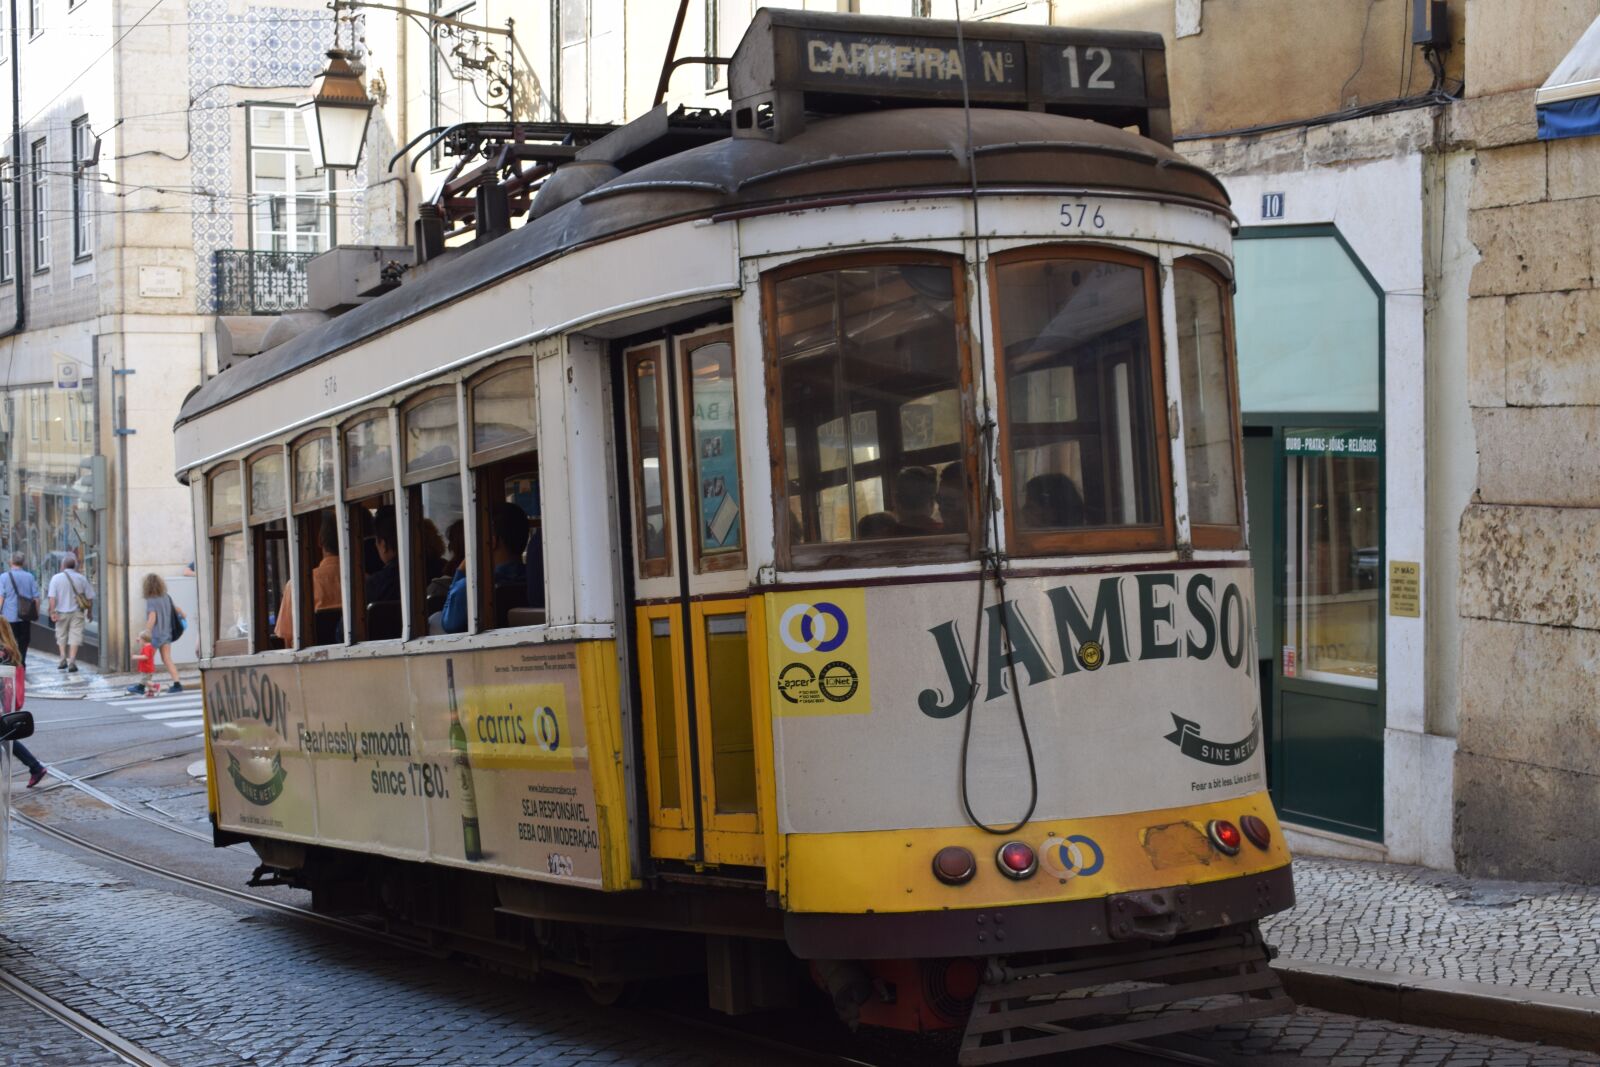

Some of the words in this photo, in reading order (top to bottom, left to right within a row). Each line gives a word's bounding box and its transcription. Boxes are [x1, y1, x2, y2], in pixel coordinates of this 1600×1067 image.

[807, 39, 965, 82] CARREIRA
[1062, 45, 1116, 91] 12
[1059, 203, 1106, 230] 576
[1266, 194, 1280, 217] 10
[324, 375, 337, 397] 576
[208, 668, 288, 743] JAMESON
[477, 703, 527, 745] carris
[297, 722, 358, 763] Fearlessly
[360, 722, 411, 757] smooth
[1201, 744, 1231, 761] SINE
[371, 760, 407, 796] since
[1191, 781, 1207, 792] Fear
[521, 798, 539, 818] SEJA
[518, 822, 537, 842] BEBA
[536, 825, 553, 844] COM
